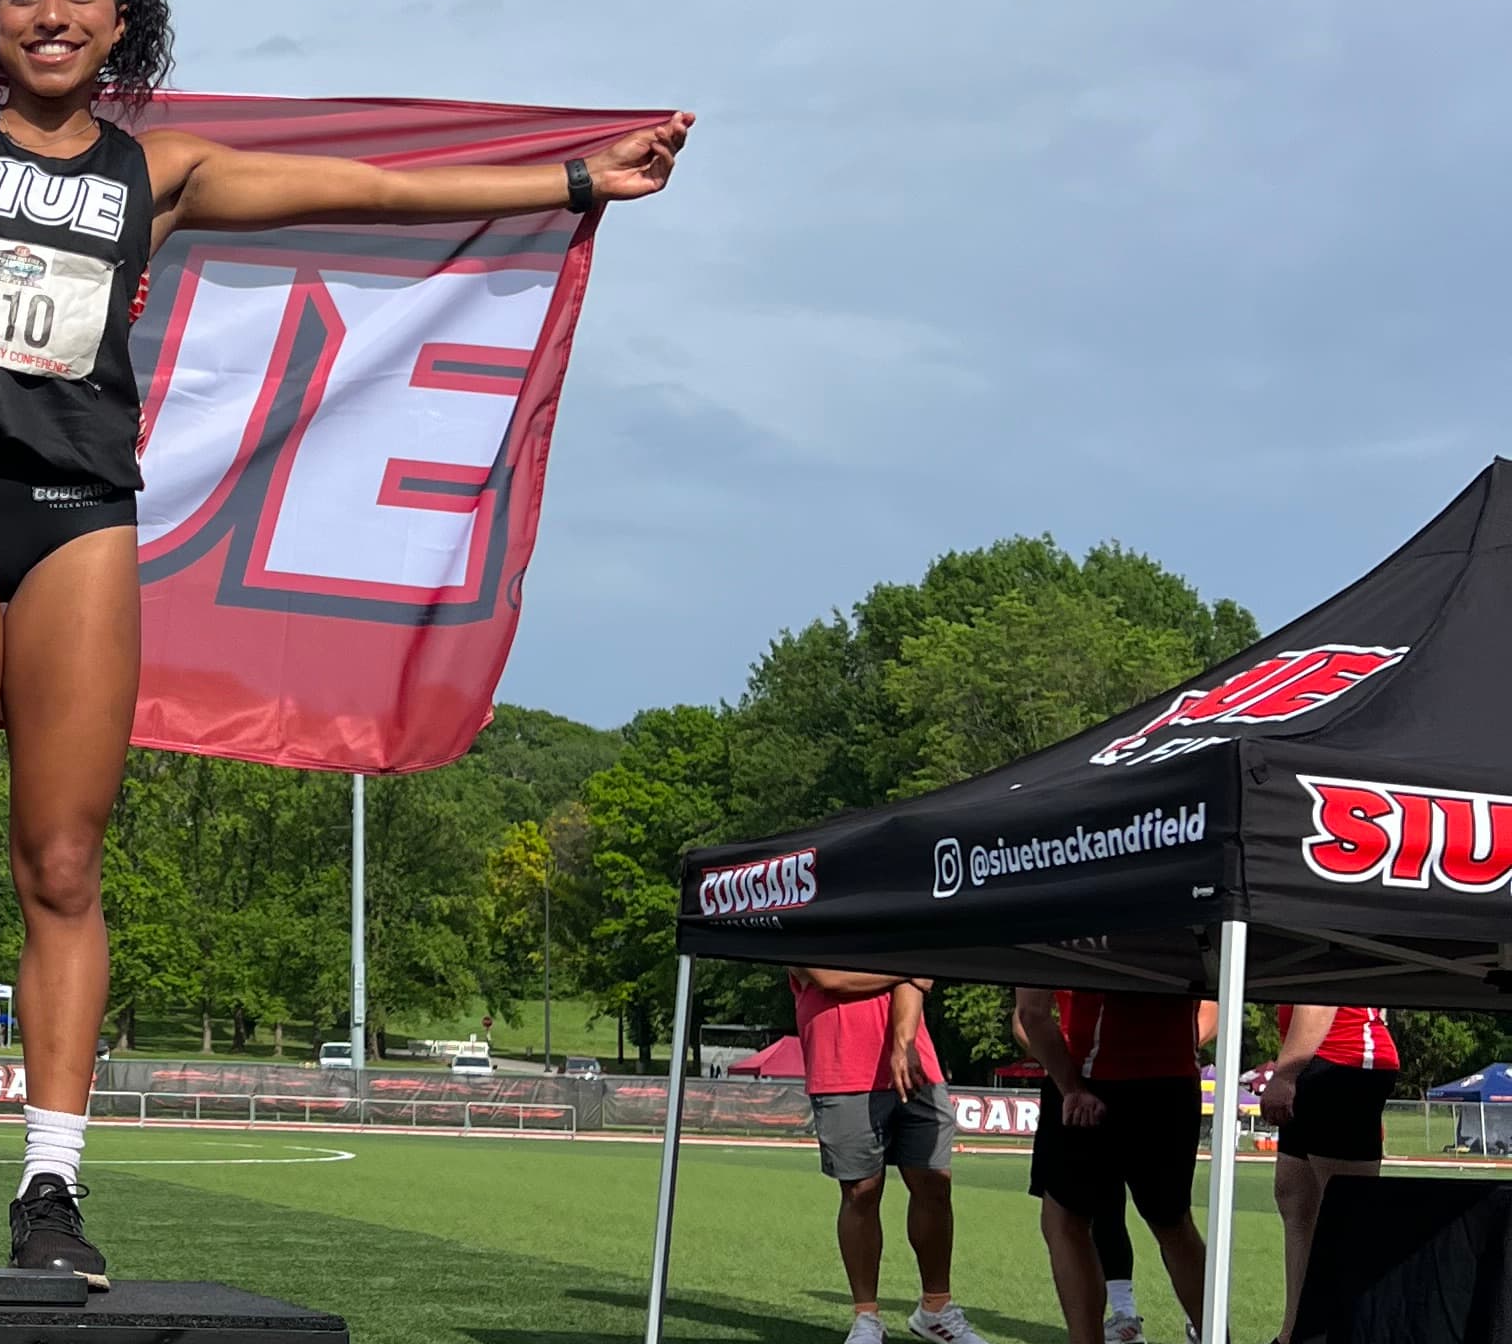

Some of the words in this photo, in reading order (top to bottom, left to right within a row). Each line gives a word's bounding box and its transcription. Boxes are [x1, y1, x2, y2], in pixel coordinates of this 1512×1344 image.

[9, 351, 73, 375] CONFERENCE
[970, 802, 1207, 887] @siuetrackandfield
[1296, 773, 1512, 894] SIU
[698, 847, 818, 917] COUGARS
